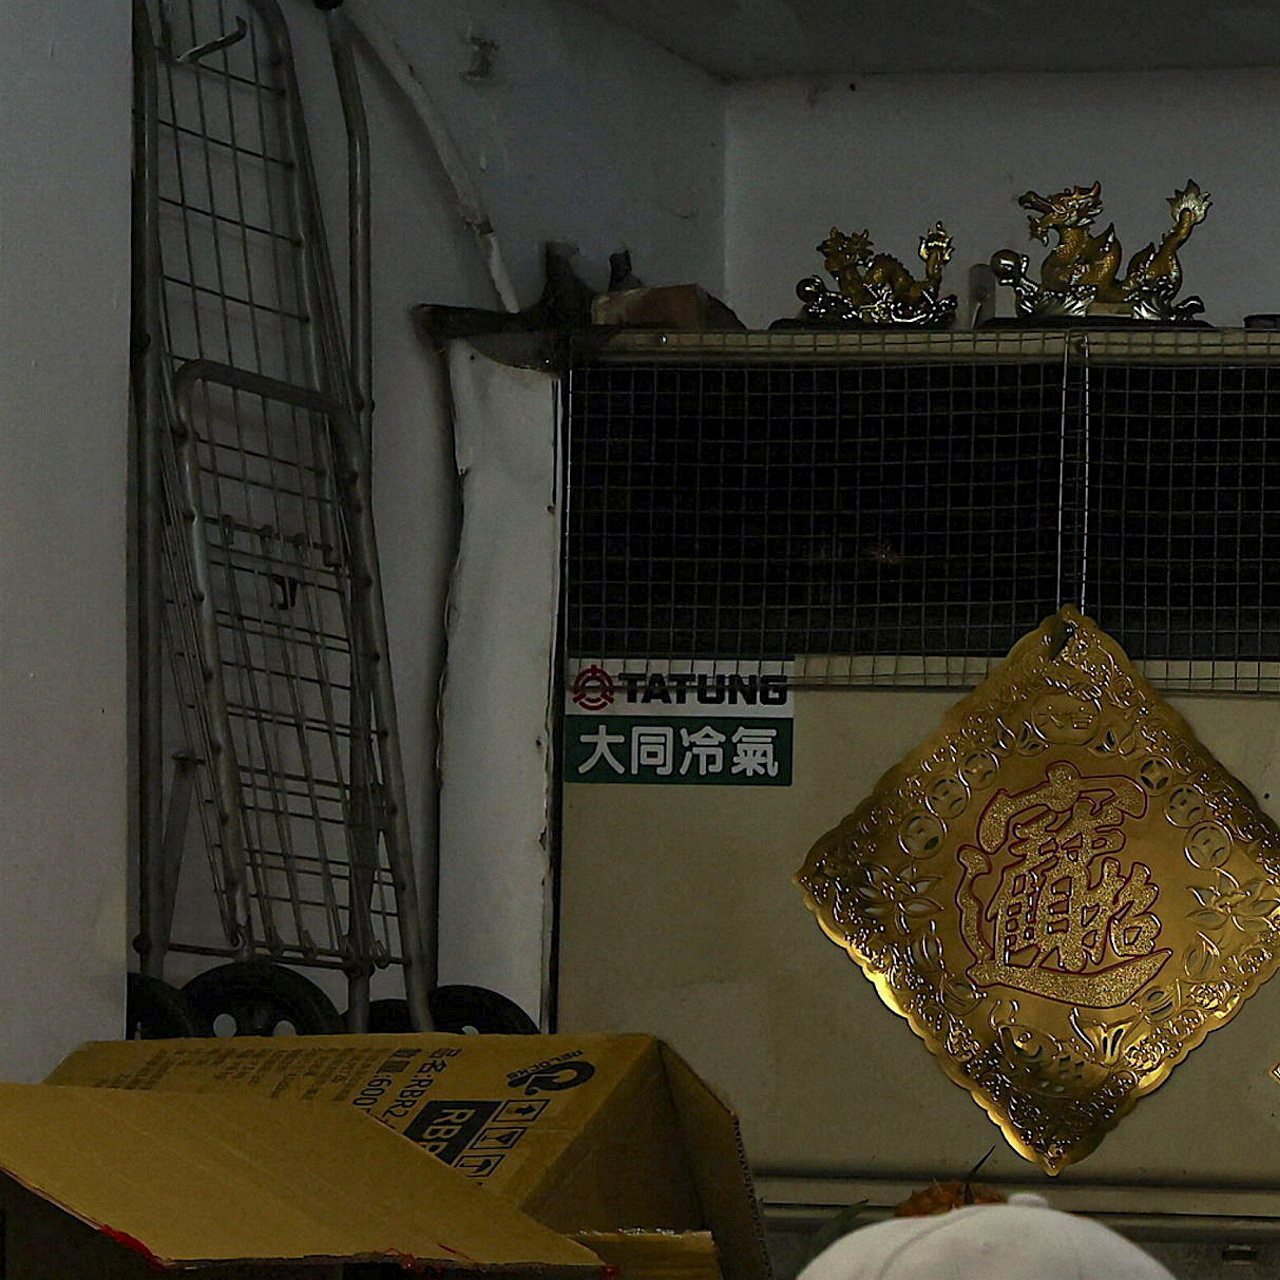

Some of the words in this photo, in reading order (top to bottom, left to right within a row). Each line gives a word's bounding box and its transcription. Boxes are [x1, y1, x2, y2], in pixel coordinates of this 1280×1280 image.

[618, 672, 788, 706] TATUNG
[577, 724, 779, 777] 大同冷氣
